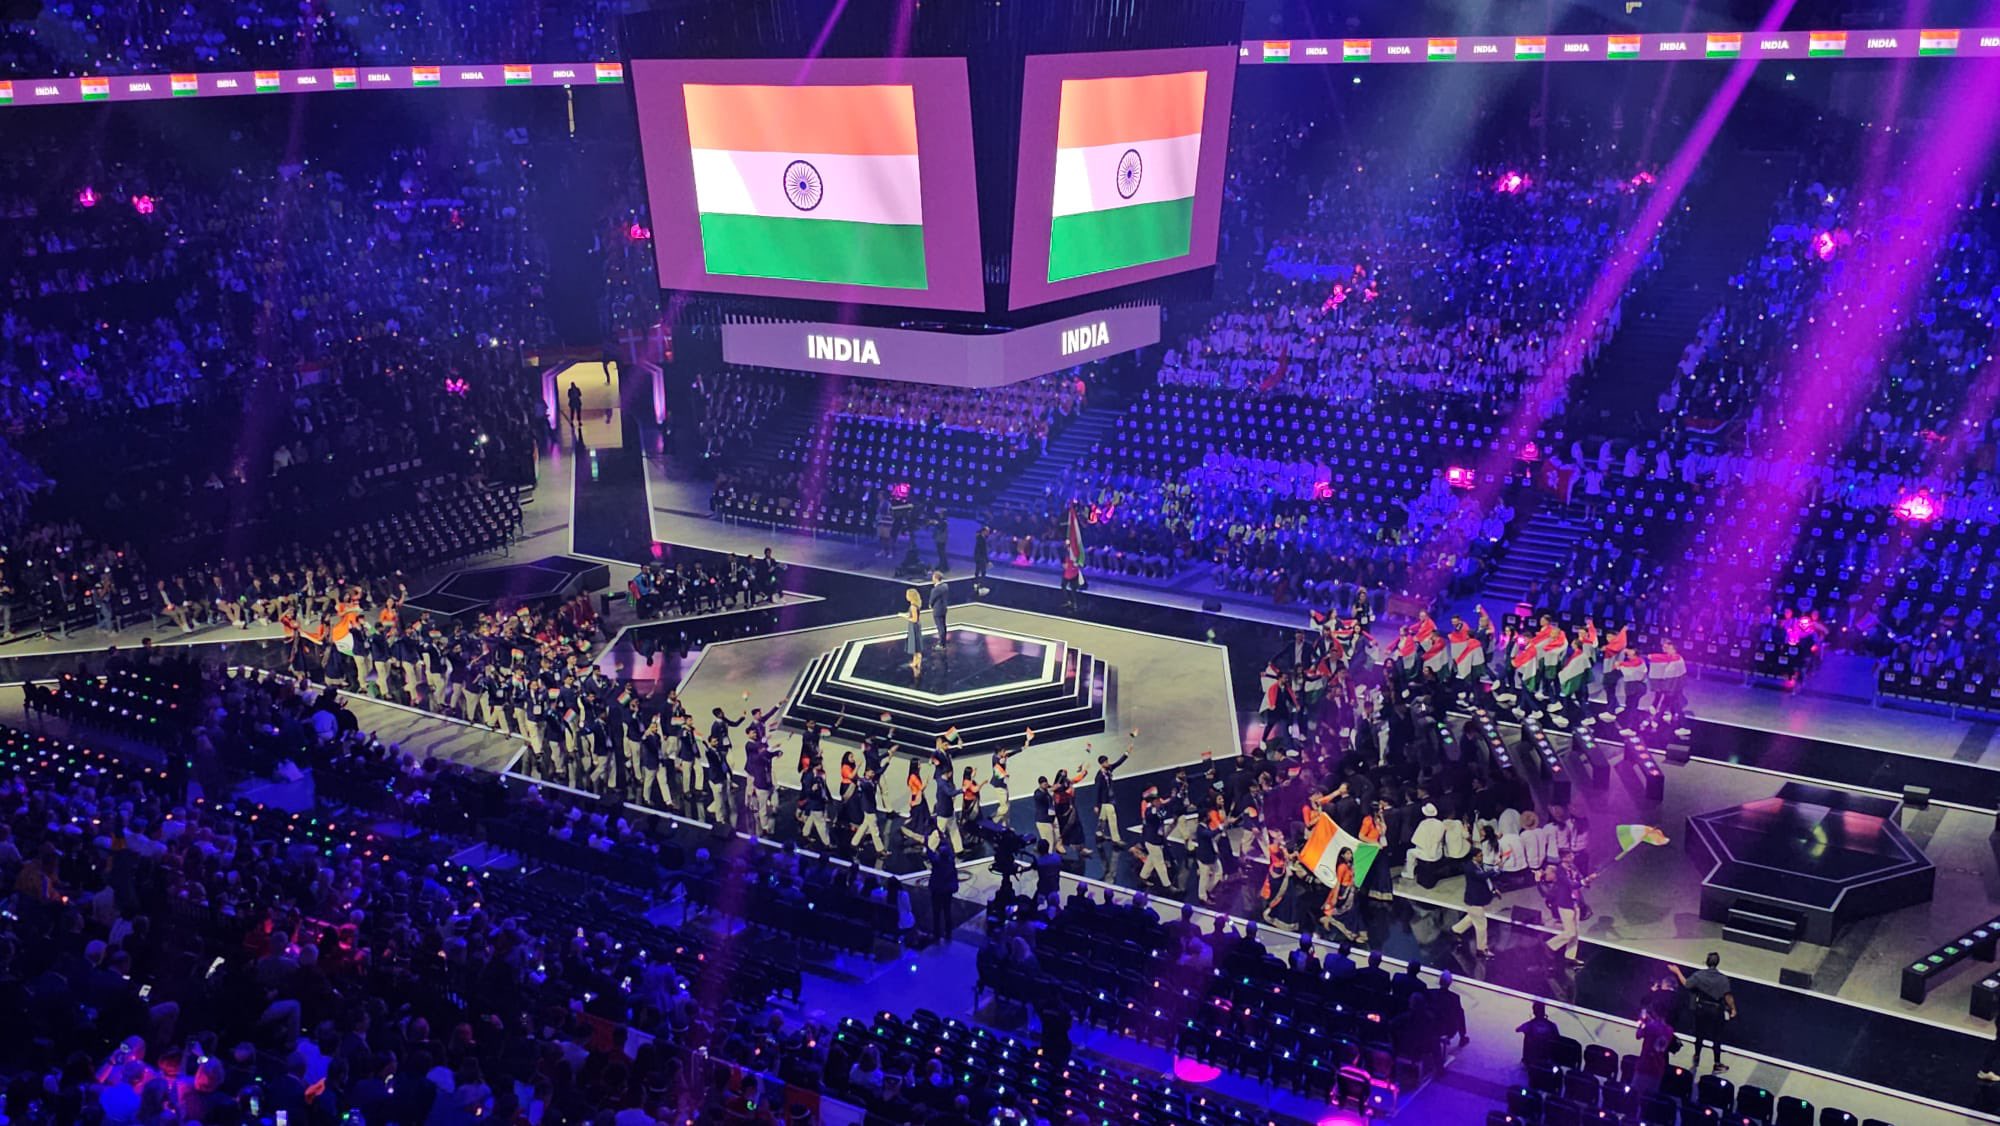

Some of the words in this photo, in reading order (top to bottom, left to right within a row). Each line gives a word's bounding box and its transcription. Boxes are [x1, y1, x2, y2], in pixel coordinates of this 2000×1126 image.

[1659, 42, 1687, 51] INDIA
[1760, 40, 1789, 50] INDIA
[1867, 38, 1898, 48] INDIA
[1305, 47, 1328, 56] INDIA
[1387, 46, 1410, 55] INDIA
[1473, 44, 1497, 54] INDIA
[1564, 43, 1590, 53] INDIA
[368, 73, 390, 82] INDIA
[461, 71, 484, 80] INDIA
[553, 70, 576, 79] INDIA
[217, 79, 238, 88] INDIA
[297, 76, 317, 84] INDIA
[35, 86, 59, 96] INDIA
[129, 82, 151, 92] INDIA
[1061, 321, 1110, 356] INDIA
[807, 334, 881, 365] INDIA
